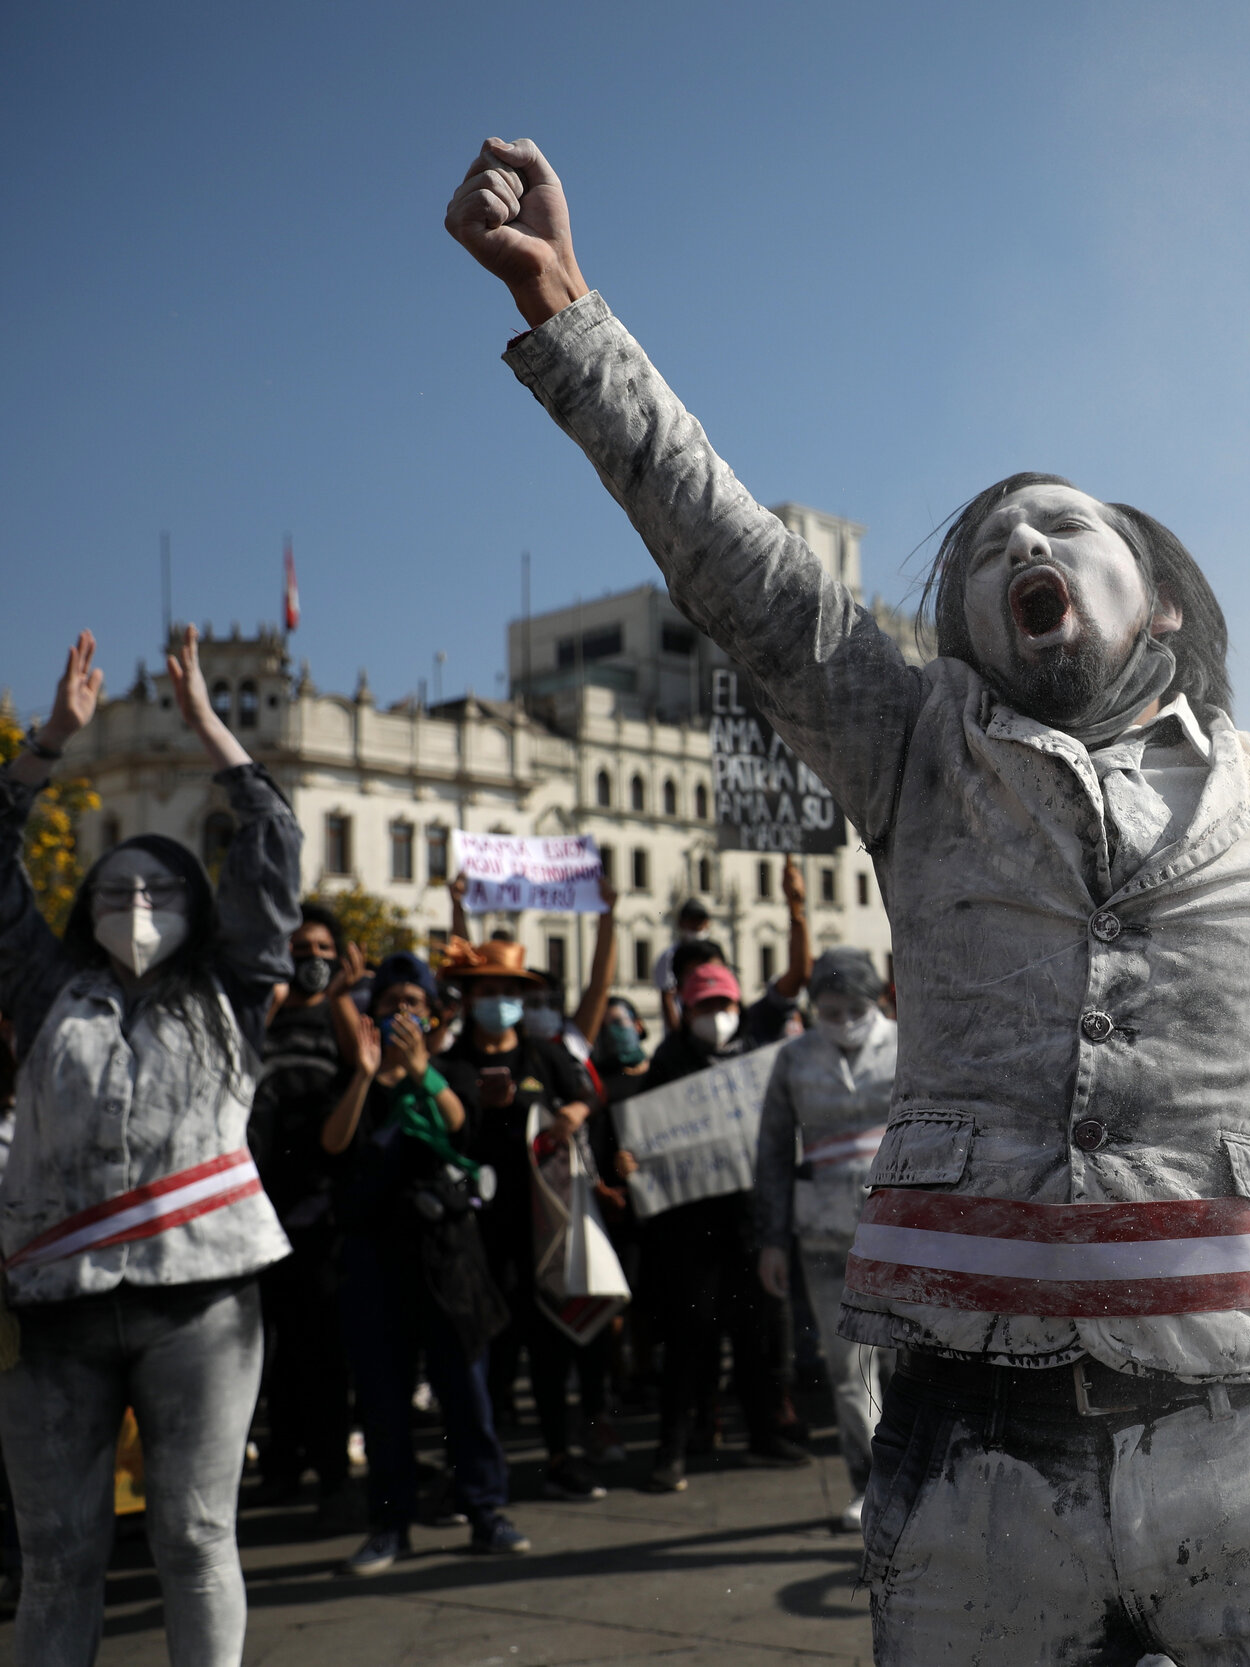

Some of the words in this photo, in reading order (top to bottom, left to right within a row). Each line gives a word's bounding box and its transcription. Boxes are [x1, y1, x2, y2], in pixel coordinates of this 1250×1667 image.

[712, 668, 746, 715] EL
[709, 716, 766, 755] AMA
[713, 753, 795, 792] PATRIA
[715, 791, 772, 825] AMA
[777, 791, 798, 825] A
[801, 795, 835, 831] SU
[471, 880, 489, 906] A
[495, 882, 522, 903] MI
